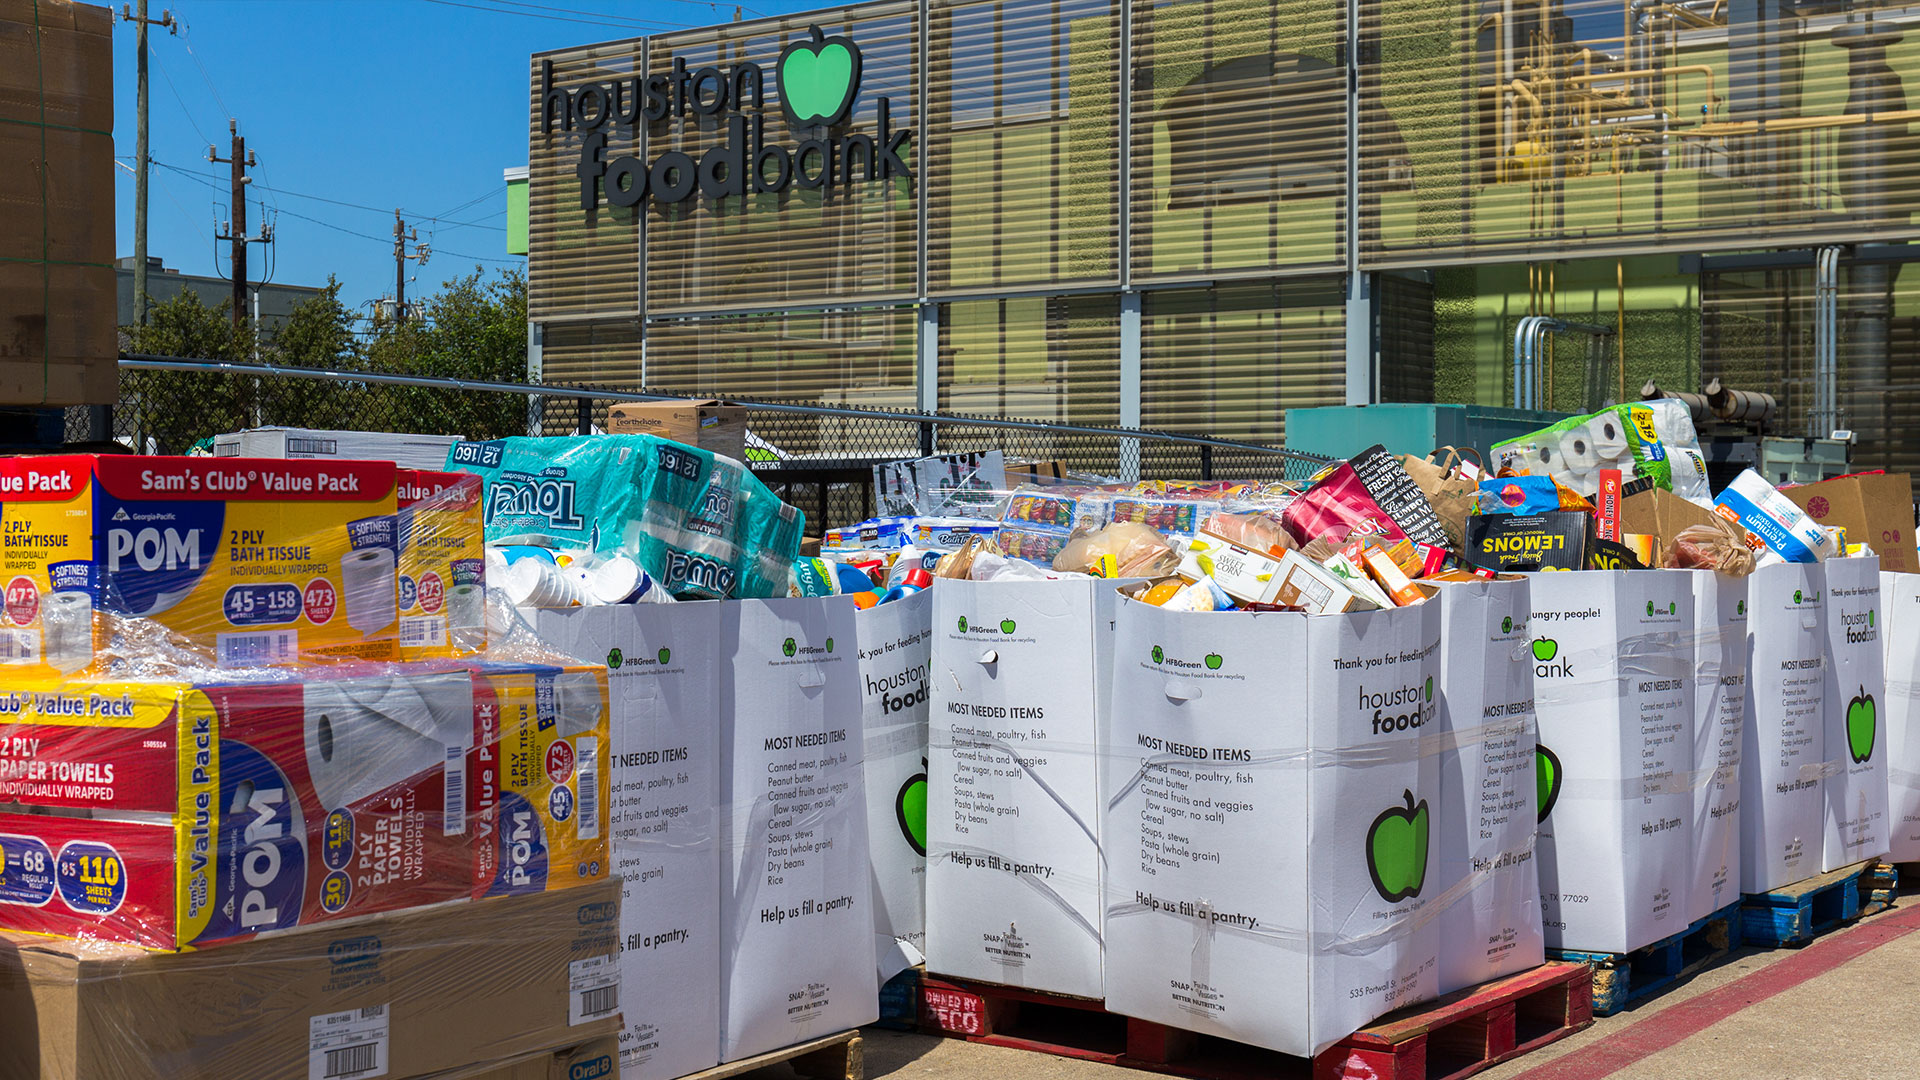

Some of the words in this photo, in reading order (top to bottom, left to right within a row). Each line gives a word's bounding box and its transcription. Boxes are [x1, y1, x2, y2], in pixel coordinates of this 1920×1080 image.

[542, 57, 763, 133] houston
[577, 97, 912, 210] foodbank
[455, 447, 477, 461] 160
[482, 451, 498, 465] 12
[685, 463, 697, 476] 12
[29, 471, 71, 491] Pack
[141, 470, 200, 491] Sam's
[262, 473, 313, 492] Value
[318, 474, 359, 491] Pack
[1367, 472, 1394, 494] FRESH
[484, 479, 585, 530] Towel
[1392, 499, 1423, 520] JUMBO
[1606, 495, 1614, 518] HONEY
[13, 521, 31, 532] PLY
[356, 521, 390, 535] SOFTNESS
[1397, 513, 1420, 527] PASTA
[4, 535, 31, 546] BATH
[34, 535, 68, 546] TISSUE
[242, 530, 264, 544] PLY
[357, 534, 390, 545] STRENGTH
[1746, 514, 1787, 551] Premium
[1772, 527, 1787, 539] BATH
[108, 527, 201, 573] POM
[439, 538, 465, 548] TISSUE
[1483, 535, 1564, 553] LEMONS
[4, 551, 48, 559] INDIVIDUALLY
[231, 547, 264, 562] BATH
[268, 547, 311, 560] TISSUE
[1218, 555, 1246, 570] SWEET
[1499, 551, 1522, 563] Fresh
[1523, 551, 1543, 563] Juicy
[4, 561, 36, 569] WRAPPED
[56, 565, 88, 577] SOFTNESS
[231, 564, 288, 576] INDIVIDUALLY
[289, 564, 328, 574] WRAPPED
[1216, 562, 1242, 576] CORN
[57, 577, 88, 587] STRENGTH
[421, 581, 441, 598] 473
[8, 588, 35, 605] 473
[231, 591, 254, 611] 45
[268, 591, 295, 609] 158
[306, 589, 334, 606] 473
[1831, 589, 1842, 597] Thank
[1564, 608, 1601, 621] people!
[1841, 608, 1867, 626] houston
[1847, 625, 1877, 644] foodbank
[868, 647, 883, 660] you
[885, 643, 896, 653] for
[898, 634, 920, 649] feeding
[625, 658, 656, 666] HFBGreen
[1165, 658, 1202, 669] HFBGreen
[1333, 656, 1363, 670] Thank
[1365, 655, 1382, 670] you
[1385, 652, 1397, 665] for
[1781, 661, 1797, 671] MOST
[866, 665, 926, 695] houston
[88, 698, 134, 716] Pack
[1359, 685, 1424, 710] houston
[948, 702, 969, 716] MOST
[972, 704, 1006, 718] NEEDED
[1010, 706, 1044, 719] ITEMS
[1372, 703, 1436, 735] foodbank
[480, 704, 492, 761] Pack
[764, 736, 792, 751] MOST
[795, 732, 828, 748] NEEDED
[829, 729, 846, 743] ITEMS
[14, 738, 39, 758] PLY
[192, 716, 211, 785] Pack
[620, 751, 659, 768] NEEDED
[661, 747, 688, 763] ITEMS
[1138, 734, 1163, 750] MOST
[1165, 742, 1208, 760] NEEDED
[1213, 748, 1251, 762] ITEMS
[1, 759, 47, 781] PAPER
[51, 763, 114, 783] TOWELS
[552, 744, 564, 784] 473
[1140, 758, 1168, 773] Canned
[1170, 767, 1192, 780] meat,
[1195, 771, 1232, 785] poultry,
[1236, 772, 1254, 784] fish
[0, 782, 63, 798] INDIVIDUALLY
[65, 785, 114, 800] WRAPPED
[648, 776, 675, 791] poultry,
[677, 772, 689, 784] fish
[1166, 776, 1188, 791] butter
[480, 770, 492, 838] Value
[554, 792, 565, 818] 45
[1171, 791, 1190, 805] fruits
[1193, 797, 1211, 809] and
[1214, 800, 1253, 813] veggies
[1141, 810, 1165, 825] Cereal
[1163, 804, 1187, 818] sugar,
[1190, 812, 1201, 820] no
[1205, 812, 1225, 824] salt)
[191, 792, 210, 873] Value
[328, 813, 342, 849] 110
[388, 796, 404, 883] TOWELS
[404, 787, 416, 881] INDIVIDUALLY
[1141, 823, 1165, 839] Soups,
[1167, 831, 1189, 844] stews
[360, 832, 373, 870] PLY
[373, 818, 388, 885] PAPER
[414, 812, 424, 880] WRAPPED
[512, 811, 531, 886] POM
[1141, 837, 1160, 850] Pasta
[1162, 842, 1189, 857] (whole
[1192, 850, 1220, 864] grain)
[23, 850, 45, 873] 68
[241, 787, 284, 928] POM
[951, 851, 972, 869] Help
[975, 859, 986, 868] us
[987, 857, 1001, 870] fill
[1014, 862, 1055, 879] pantry.
[1141, 850, 1154, 864] Dry
[1156, 854, 1180, 868] beans
[79, 856, 119, 886] 110
[1141, 863, 1156, 875] Rice
[86, 885, 112, 896] SHEETS
[326, 877, 342, 906] 30
[1563, 895, 1589, 903] 77029
[580, 904, 616, 920] Oral-B
[760, 907, 785, 924] Help
[788, 906, 800, 918] us
[802, 901, 814, 916] fill
[825, 896, 854, 915] pantry.
[1135, 890, 1159, 912] Help
[1163, 902, 1176, 913] us
[1179, 900, 1194, 917] fill
[1211, 909, 1260, 930] pantry.
[628, 933, 641, 951] fill
[654, 927, 689, 949] pantry.
[1350, 988, 1364, 999] 535
[1365, 982, 1389, 996] Portwall
[926, 991, 960, 1008] OWNED
[963, 997, 977, 1011] BY
[572, 1057, 610, 1080] Oral-B
